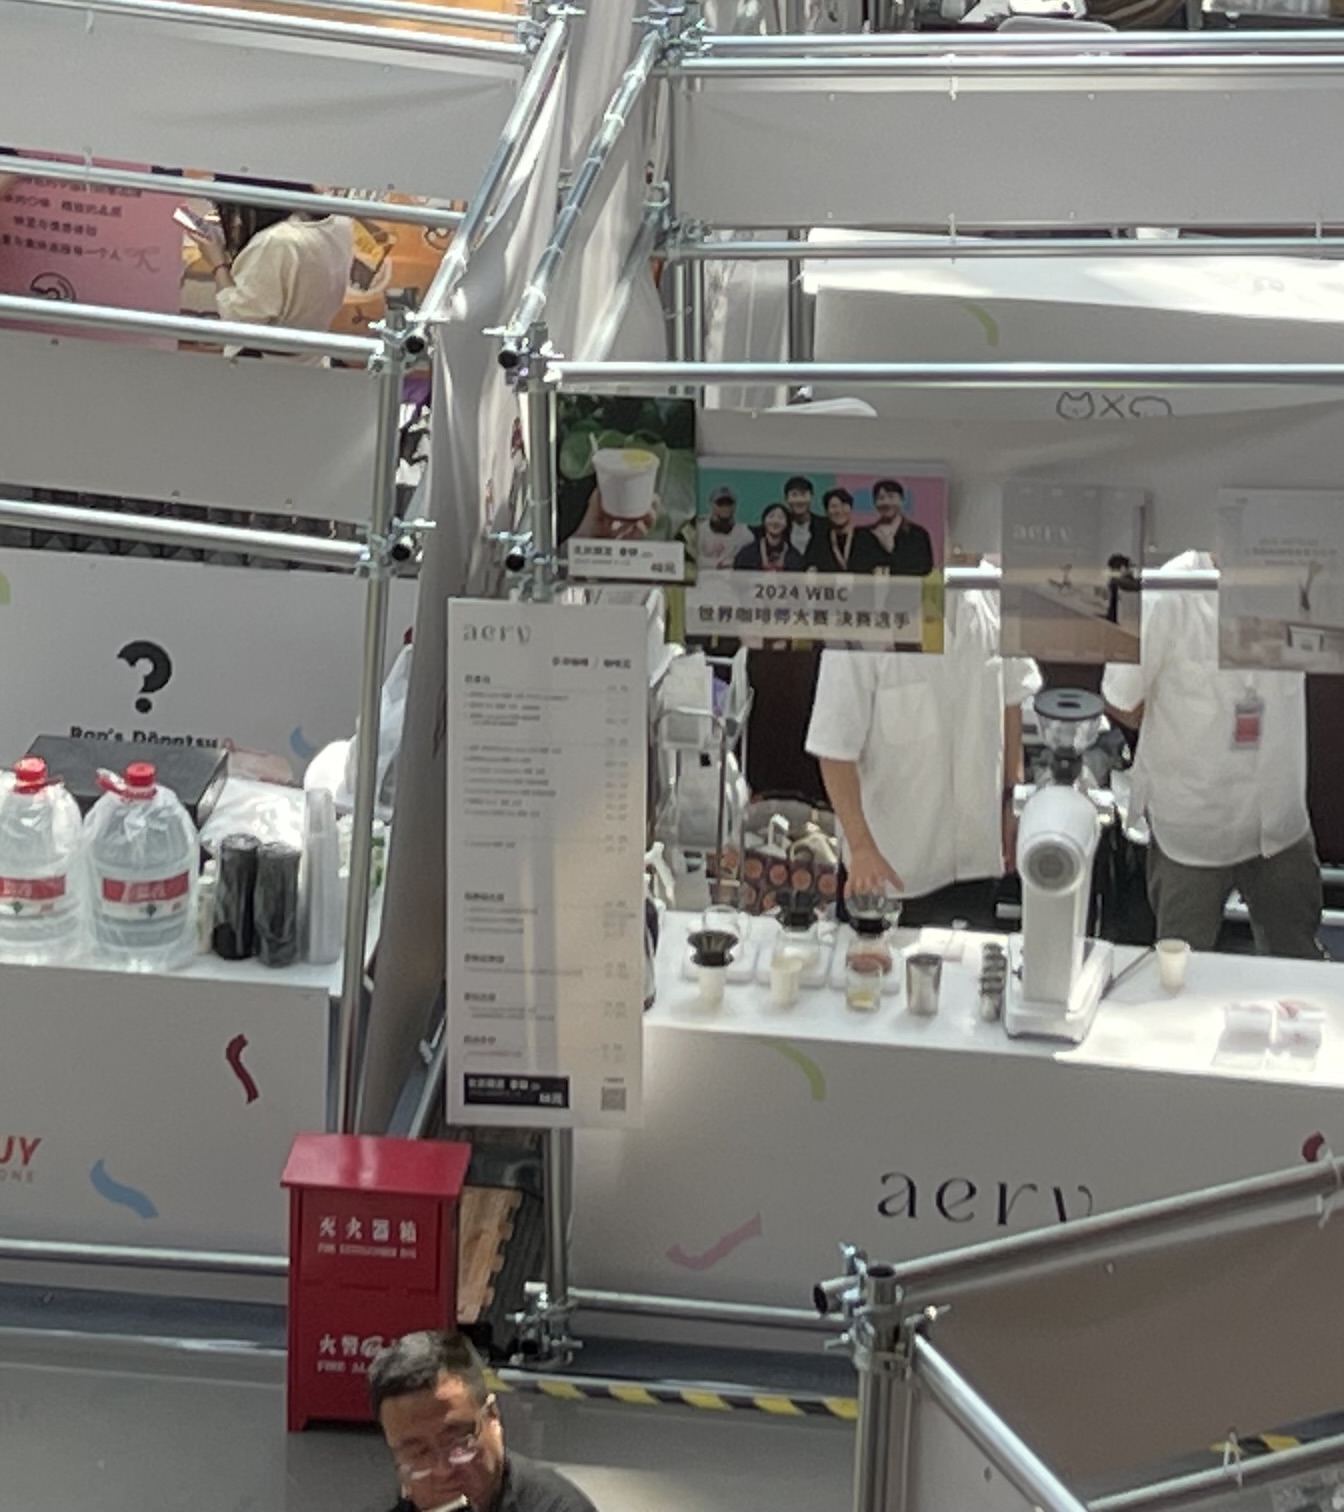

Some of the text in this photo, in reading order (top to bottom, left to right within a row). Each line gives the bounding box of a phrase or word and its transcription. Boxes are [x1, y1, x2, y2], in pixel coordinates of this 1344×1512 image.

[754, 583, 849, 602] 2024 WBC
[698, 605, 912, 630] 世界咖啡师大赛 决赛选手
[318, 1215, 417, 1244] 灭火器箱
